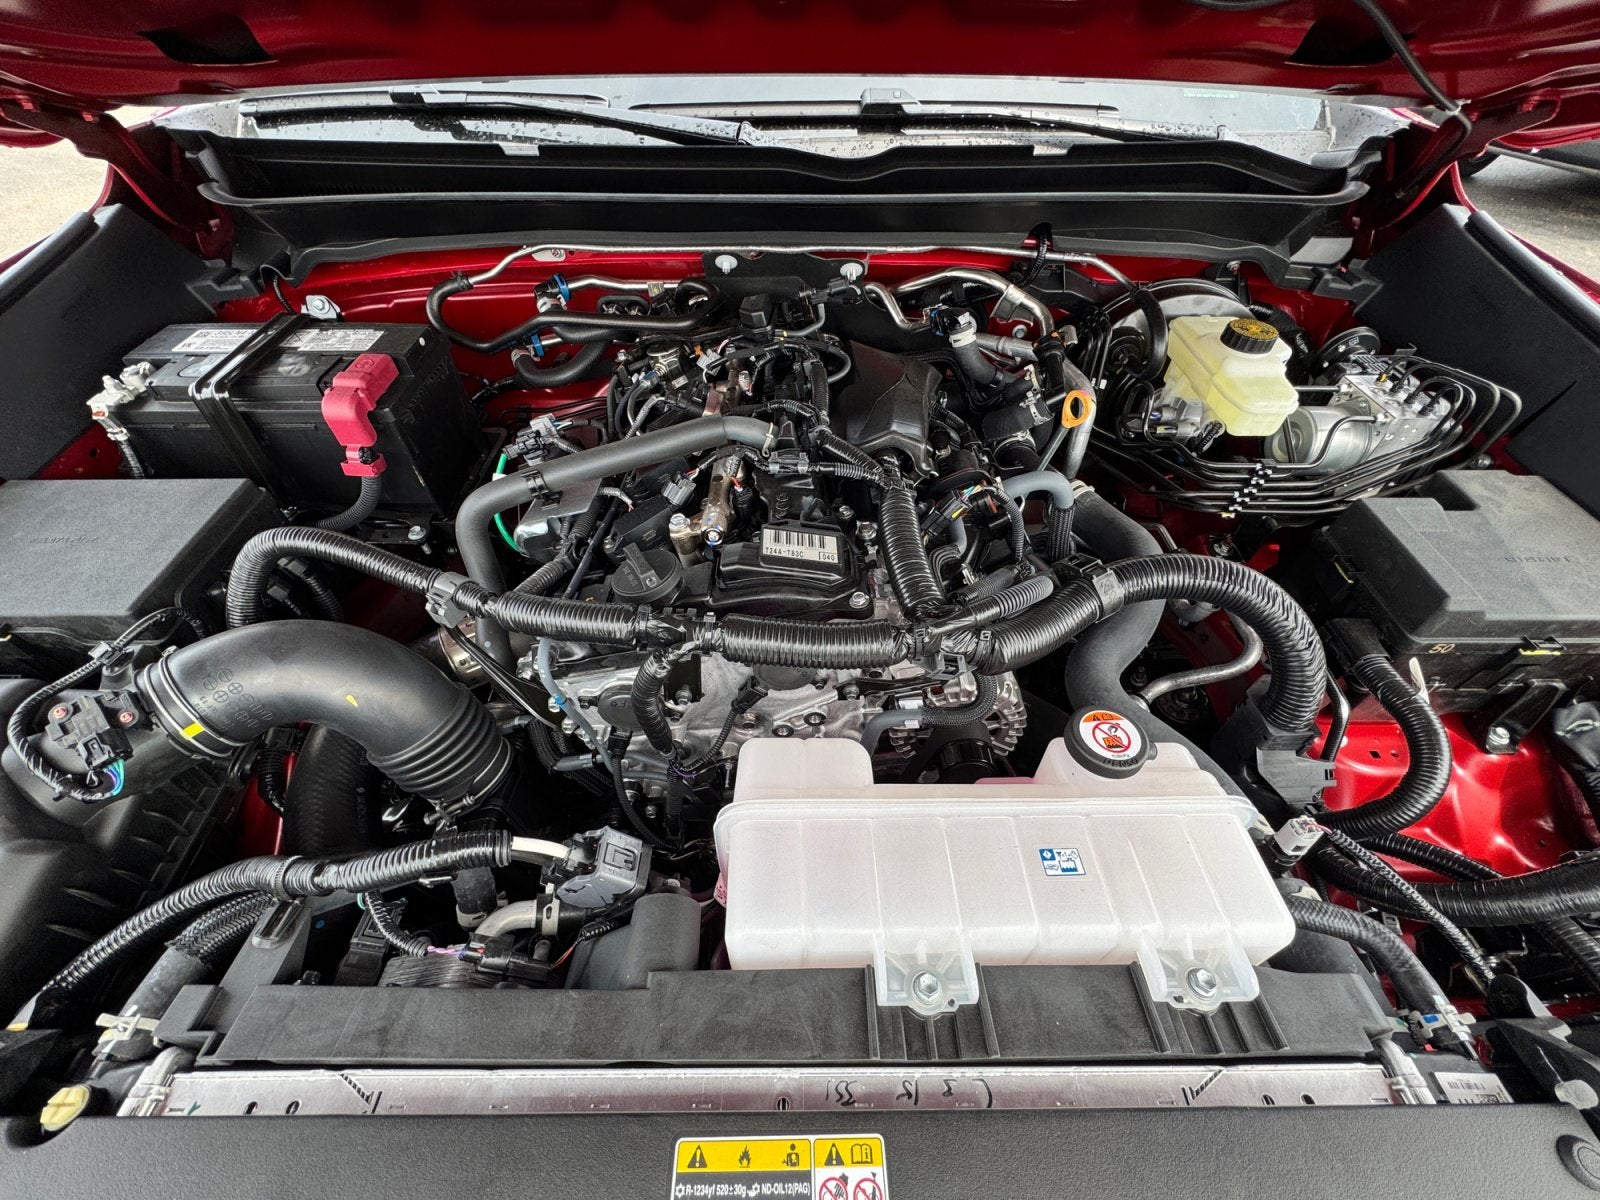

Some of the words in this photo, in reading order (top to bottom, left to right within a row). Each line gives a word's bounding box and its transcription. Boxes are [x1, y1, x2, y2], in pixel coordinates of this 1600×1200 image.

[1428, 643, 1456, 654] 50
[1102, 758, 1139, 768] DENSO
[685, 1183, 715, 1198] R-1234yf
[715, 1183, 747, 1198] 520±30g
[761, 1182, 811, 1197] ND-OIL12(PAG)
